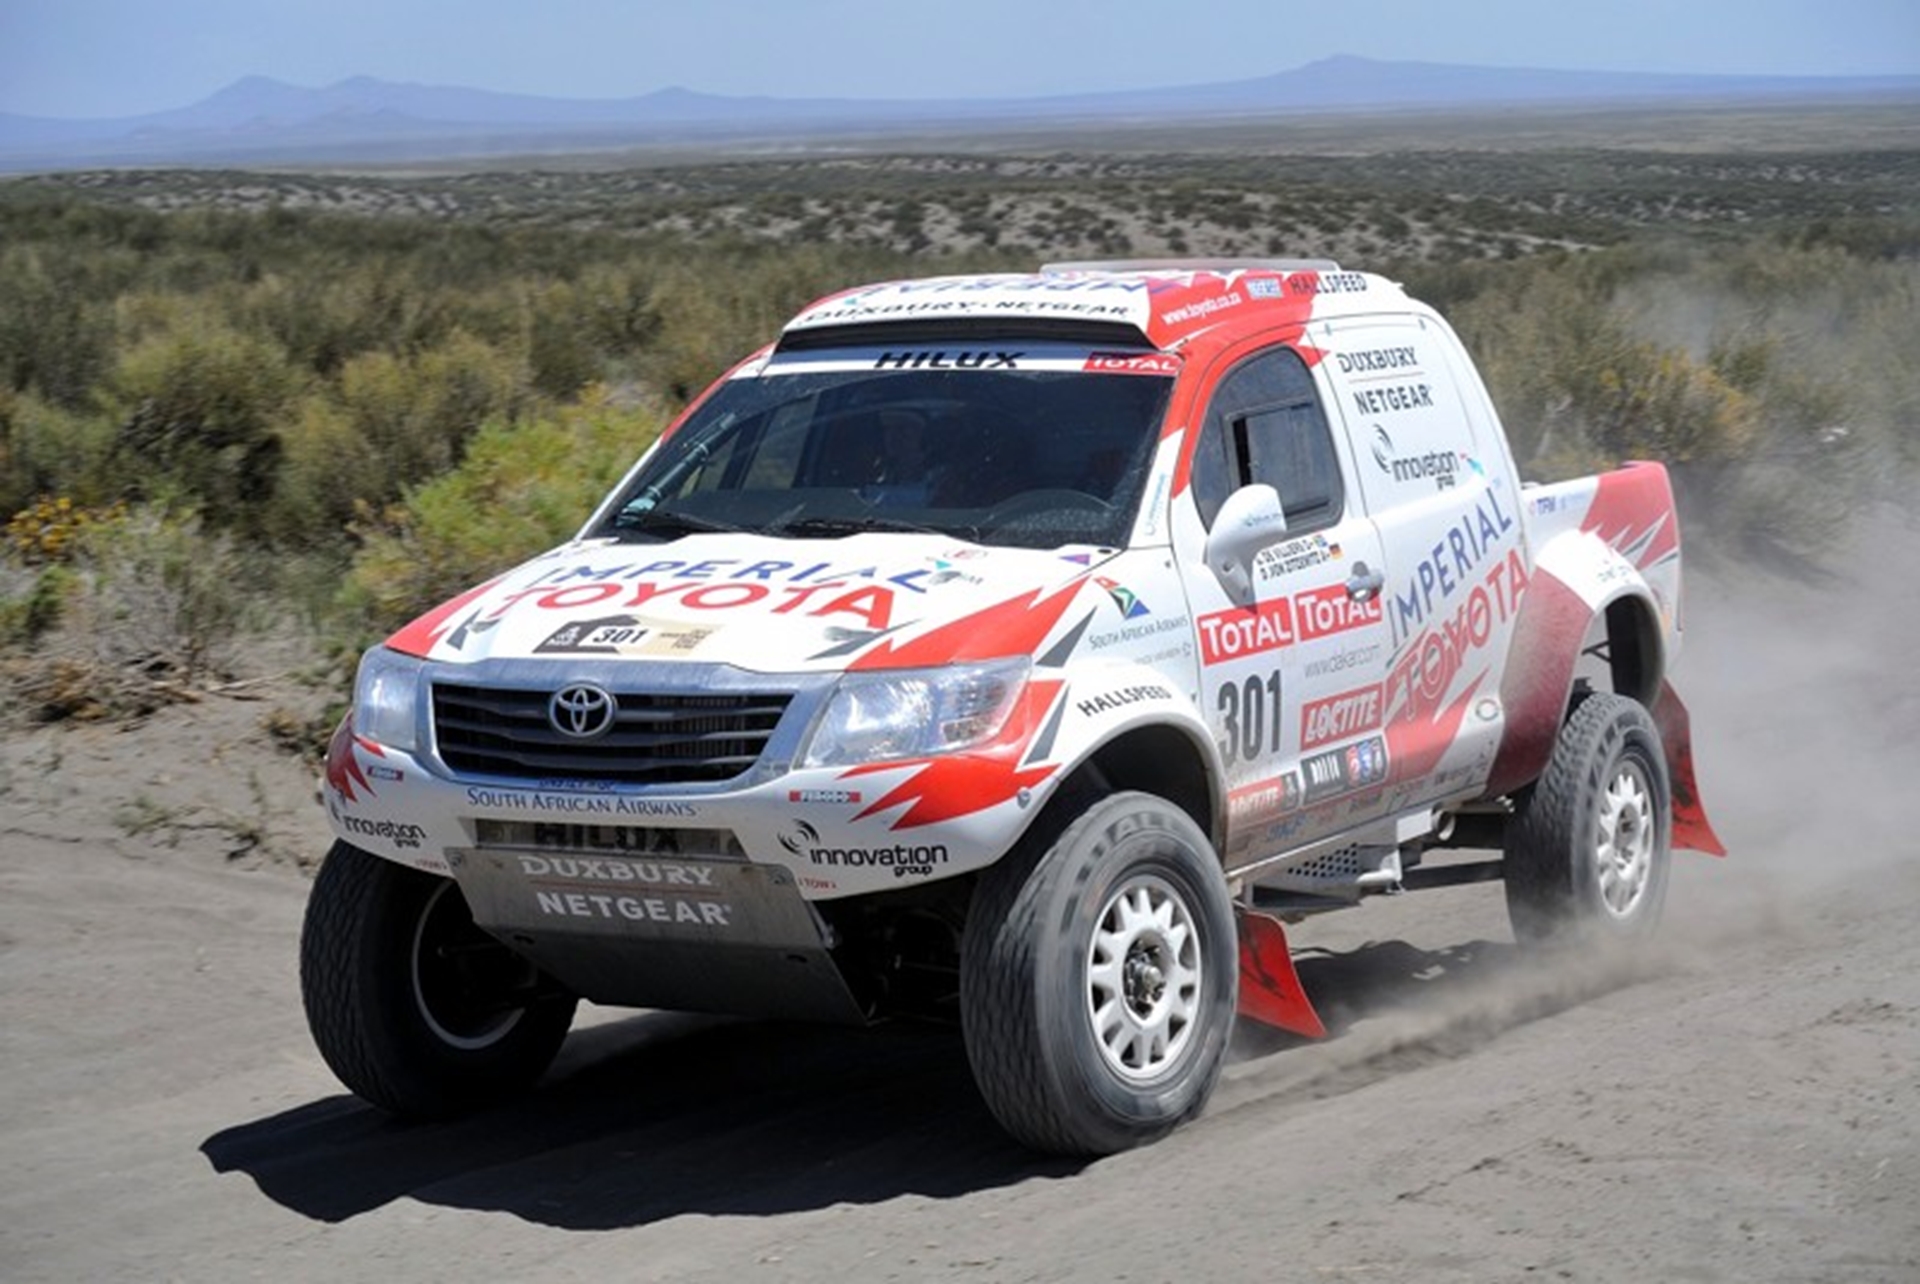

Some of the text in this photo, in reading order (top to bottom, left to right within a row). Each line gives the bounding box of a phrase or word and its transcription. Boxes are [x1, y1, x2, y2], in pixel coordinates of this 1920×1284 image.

[873, 351, 1027, 369] HILUX
[1093, 355, 1176, 371] TOTAL
[1336, 346, 1418, 373] DUXBURY
[1353, 384, 1434, 416] NETGEAR
[525, 558, 934, 594] IMPERIAL
[1387, 486, 1513, 649] IMPERIAL
[487, 581, 896, 630] TOYOTA
[591, 628, 649, 644] 301
[1201, 614, 1291, 657] TOTAL
[1297, 594, 1381, 633] TOTAL
[1396, 548, 1530, 721] TOYOTA
[1077, 685, 1172, 717] HALLSPEED
[1305, 689, 1379, 742] LOCTITE
[1218, 669, 1282, 770] 301
[466, 786, 697, 817] SOUTH AFRICAN AIRWAYS
[342, 815, 427, 839] innovation
[535, 823, 680, 852] HILUX
[809, 844, 948, 866] innovation
[893, 864, 933, 877] group
[518, 856, 713, 886] DUXBURY
[536, 891, 731, 926] NETGEAR
